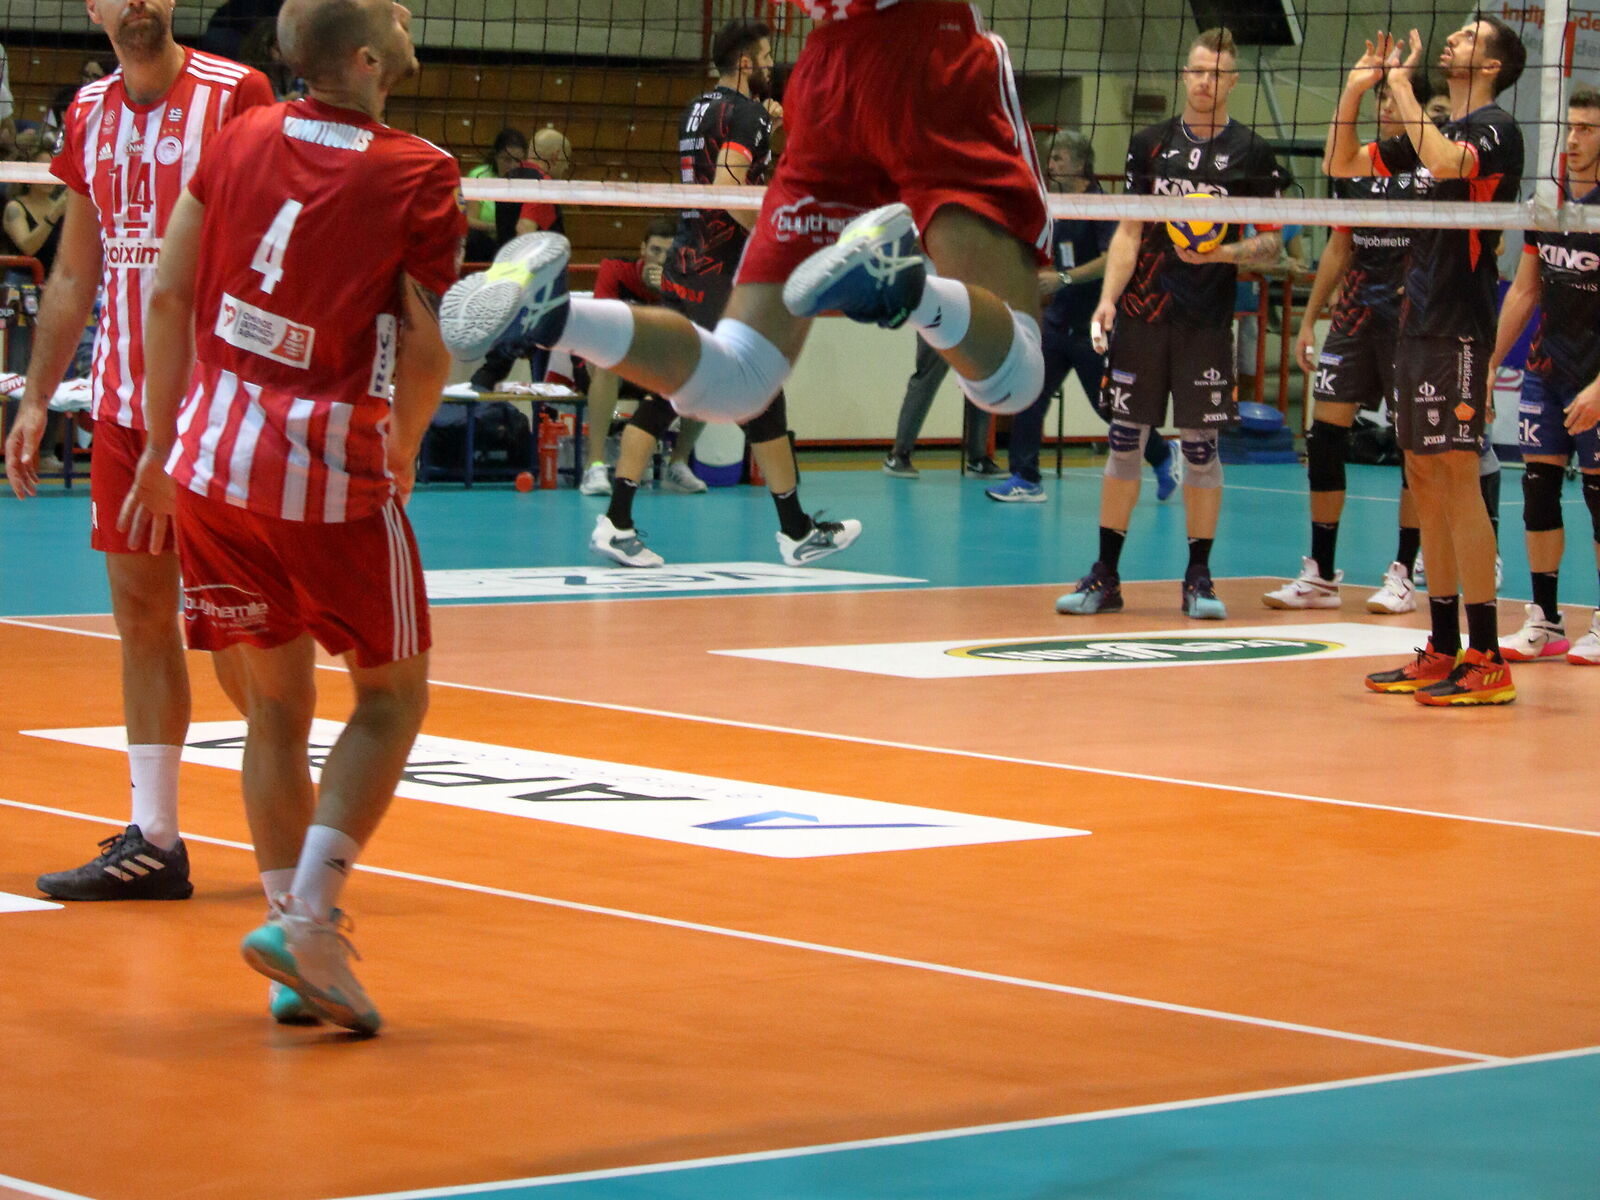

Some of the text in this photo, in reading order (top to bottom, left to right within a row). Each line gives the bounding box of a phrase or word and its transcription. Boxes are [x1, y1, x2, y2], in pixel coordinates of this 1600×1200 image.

[1187, 147, 1202, 171] 9
[108, 162, 155, 215] 14
[250, 197, 304, 295] 4
[1536, 241, 1600, 273] KING
